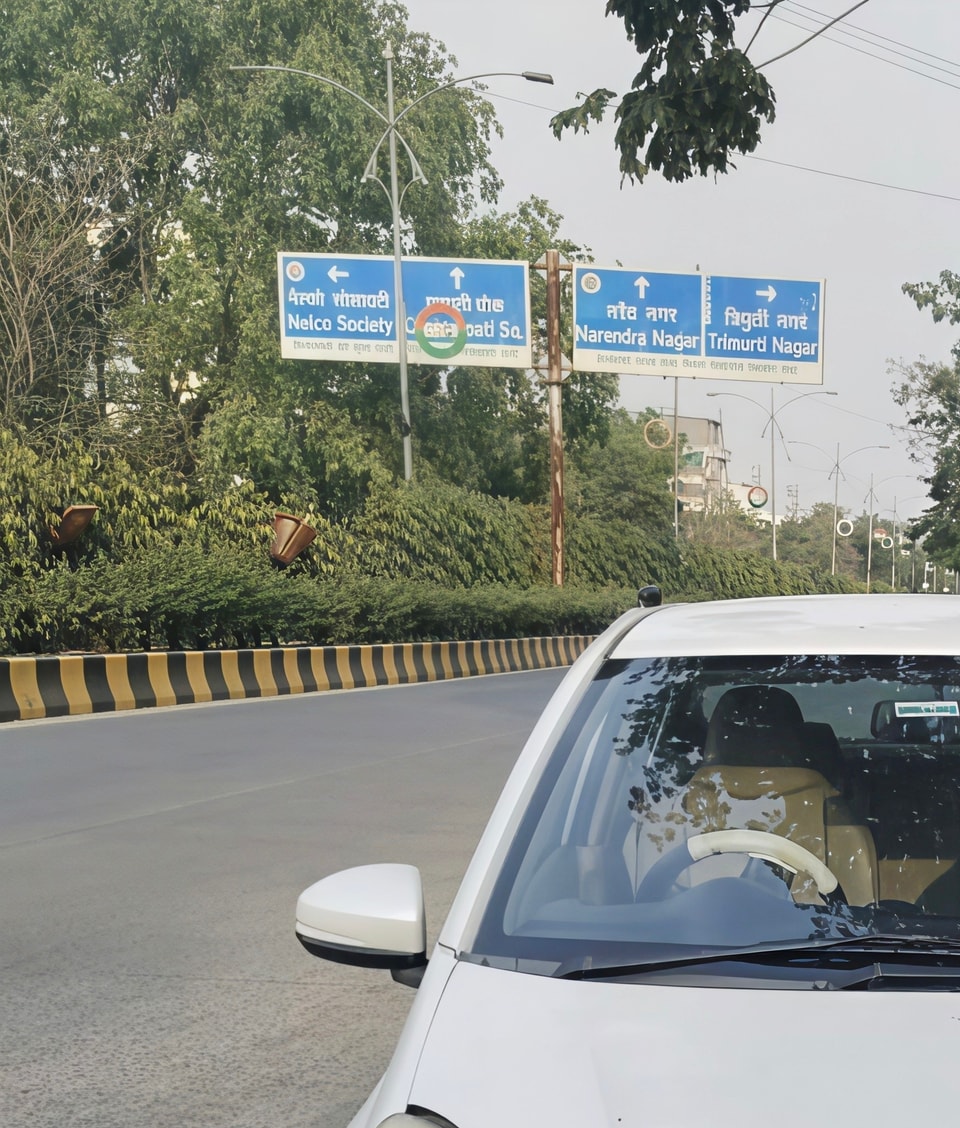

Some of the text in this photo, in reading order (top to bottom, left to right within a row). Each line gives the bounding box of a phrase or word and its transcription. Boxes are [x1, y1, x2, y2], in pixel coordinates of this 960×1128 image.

[336, 314, 393, 336] Society
[575, 324, 700, 351] Narendra Nagar
[772, 336, 818, 358] Nagar
